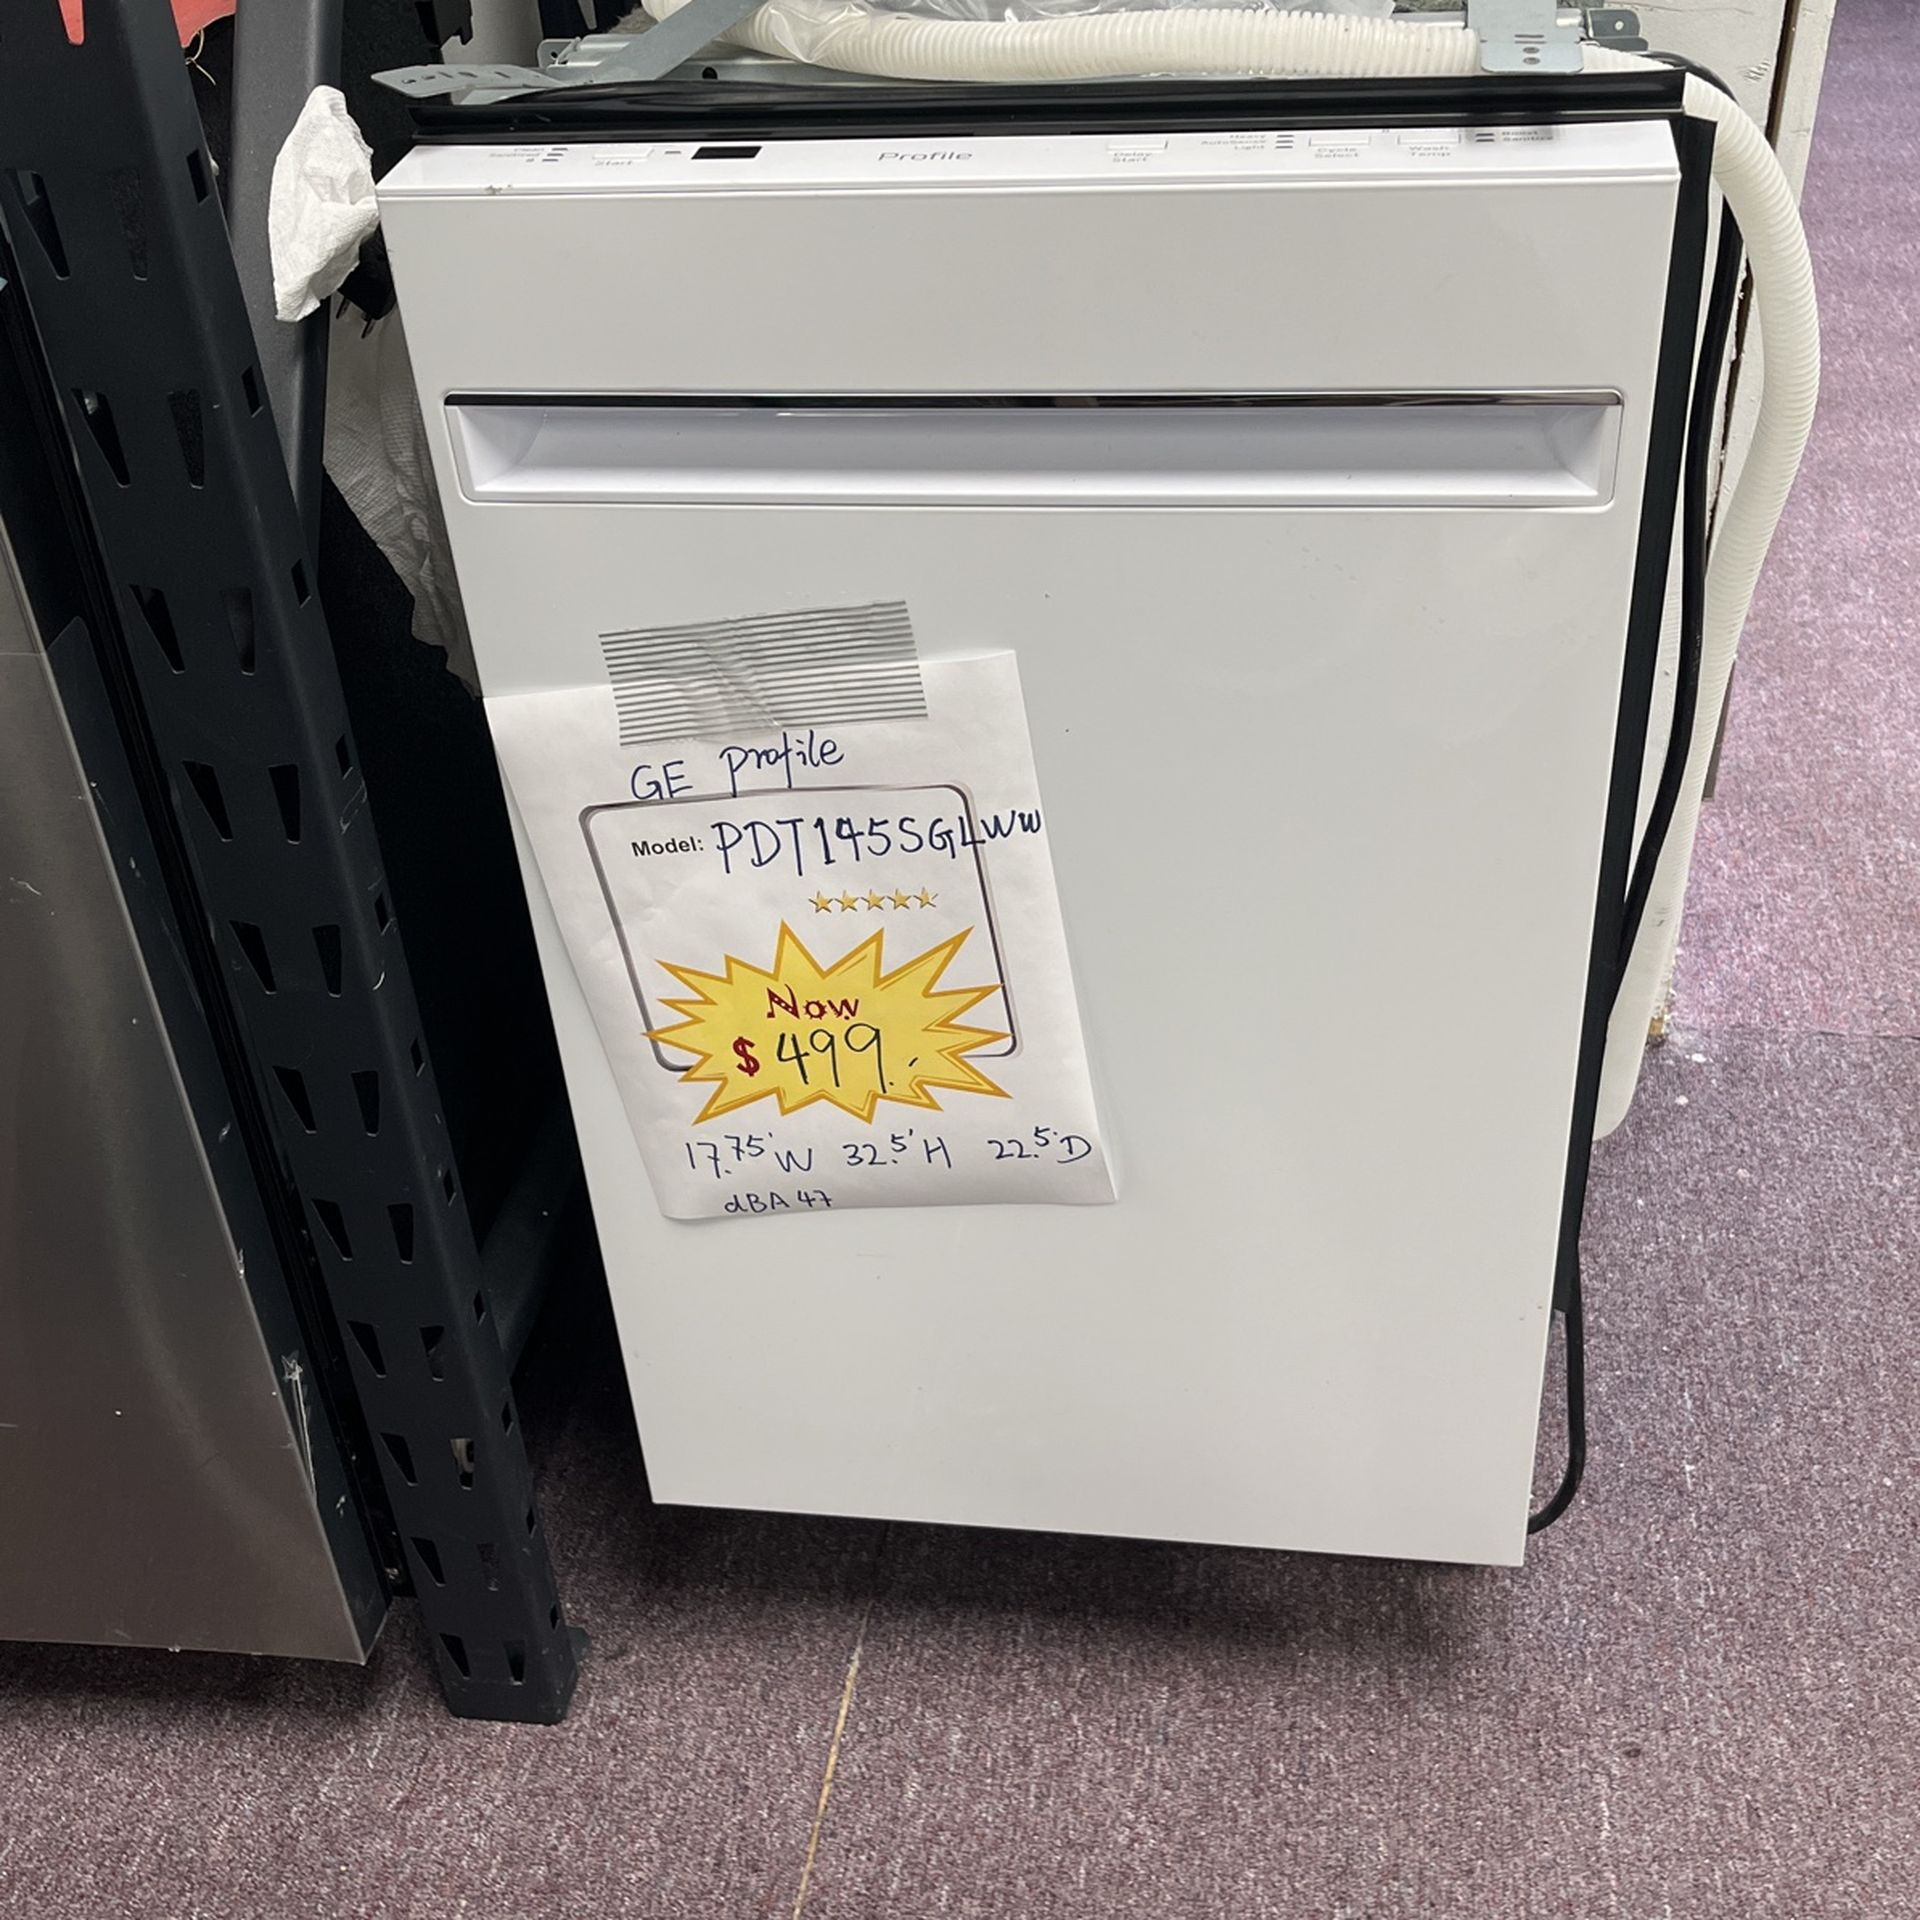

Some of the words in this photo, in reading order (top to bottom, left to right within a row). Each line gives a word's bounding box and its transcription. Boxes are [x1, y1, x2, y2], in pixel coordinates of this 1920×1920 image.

[879, 151, 973, 161] Profile
[630, 760, 694, 800] GE
[631, 838, 705, 857] Model:
[766, 984, 860, 1021] Now
[796, 1190, 833, 1208] 47
